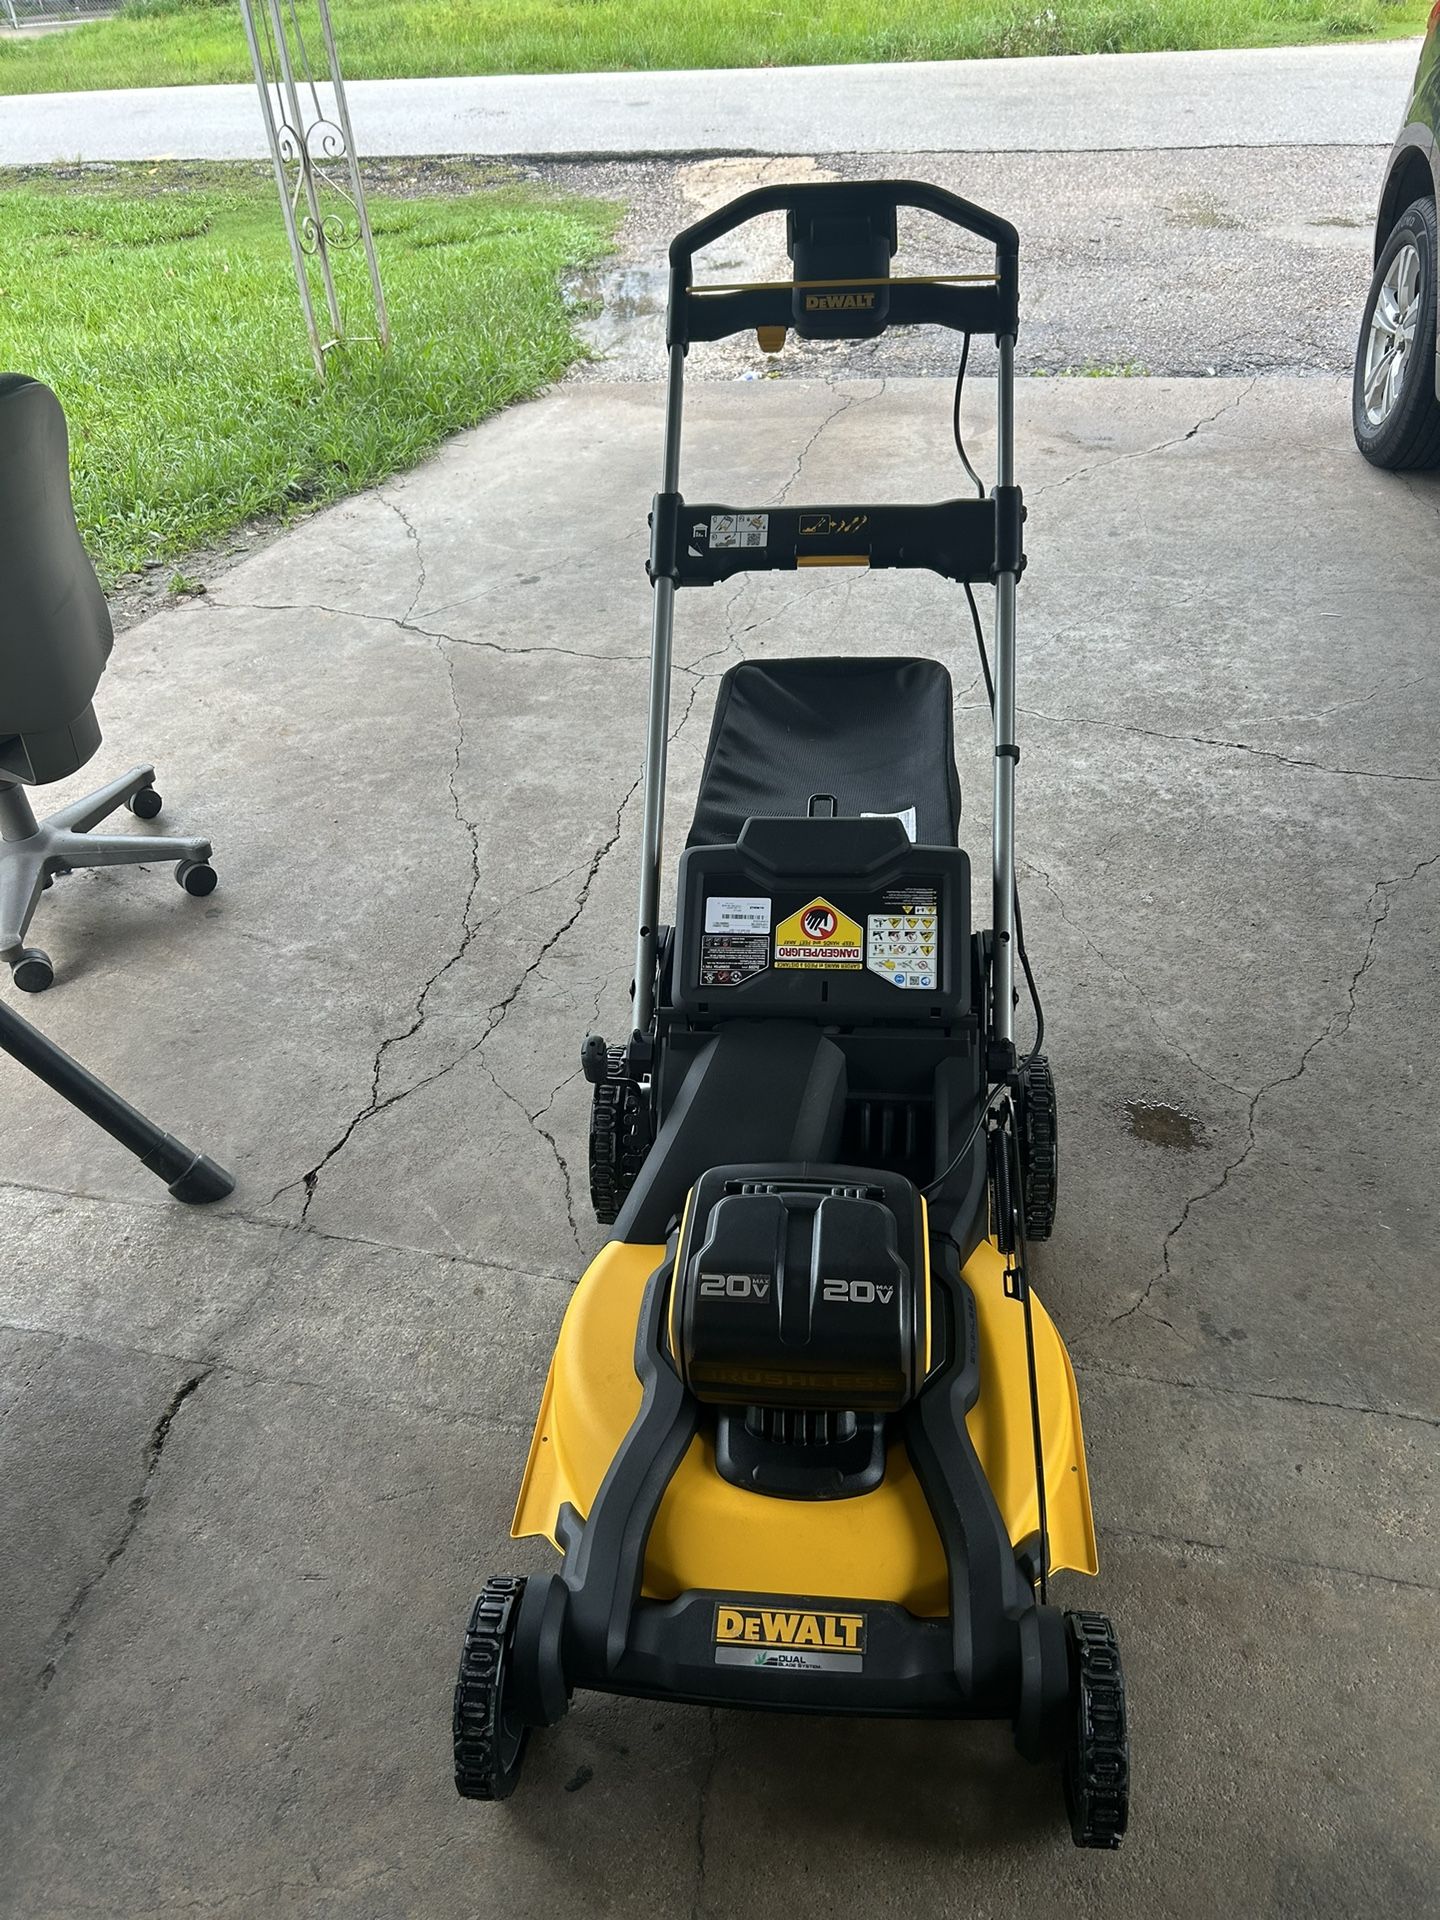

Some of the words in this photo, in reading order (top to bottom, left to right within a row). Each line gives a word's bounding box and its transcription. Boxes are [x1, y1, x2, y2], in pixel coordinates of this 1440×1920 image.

[806, 295, 875, 309] DEWALT
[778, 947, 860, 958] DANGER/PELIGRO
[705, 1370, 896, 1388] RUSHLESS
[716, 1610, 863, 1647] DEWALT
[778, 1654, 807, 1664] DUAL
